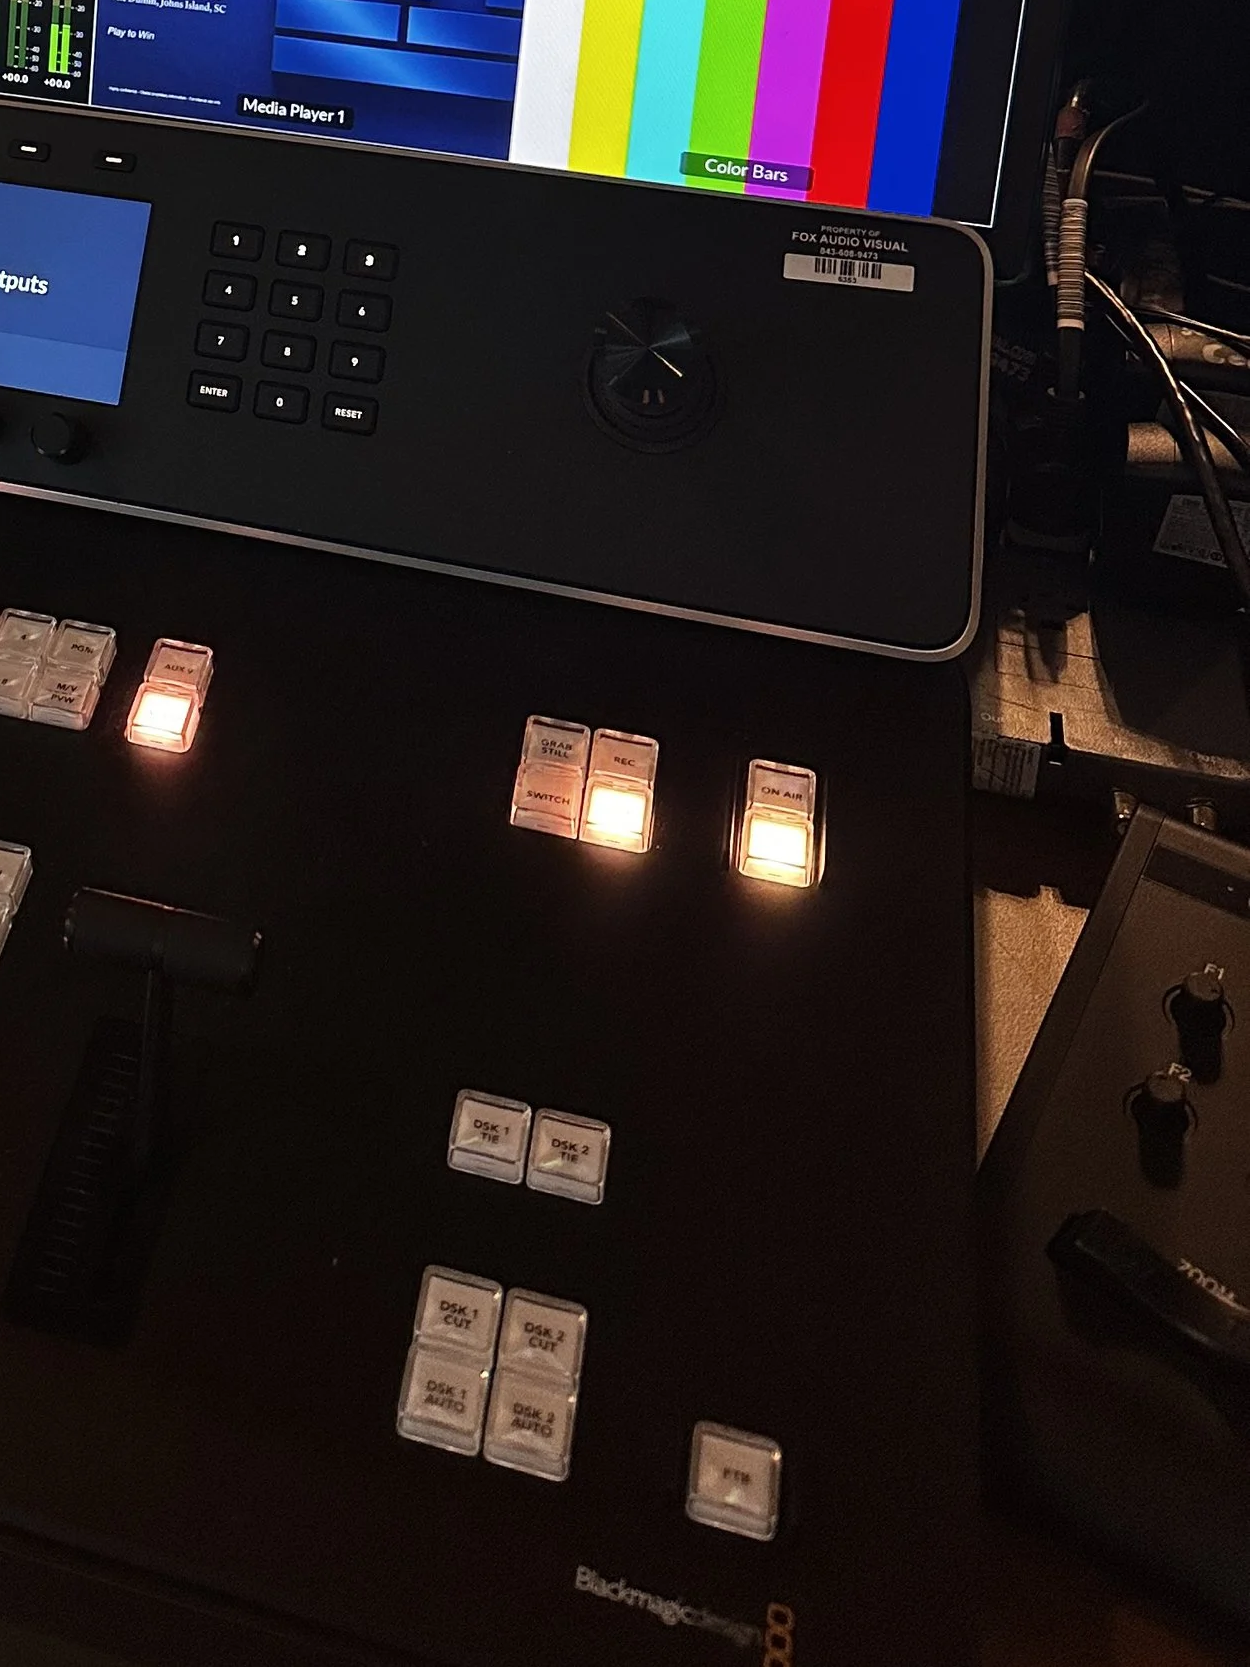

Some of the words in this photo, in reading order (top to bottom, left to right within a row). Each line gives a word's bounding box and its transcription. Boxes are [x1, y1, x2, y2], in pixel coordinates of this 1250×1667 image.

[185, 1, 212, 13] Island,
[214, 4, 226, 13] SC
[107, 26, 126, 38] Play
[127, 29, 136, 38] to
[138, 30, 155, 40] Win
[243, 98, 287, 116] Media
[290, 103, 335, 123] Player
[338, 110, 345, 124] 1
[704, 157, 749, 178] Color
[752, 163, 789, 183] Bars
[821, 225, 866, 237] PROPERTY
[792, 231, 817, 242] FOX
[819, 234, 860, 246] AUDIO
[863, 238, 909, 252] VISUAL
[200, 386, 228, 397] ENTER
[335, 408, 362, 420] RESET
[541, 739, 573, 751] GRAB
[542, 746, 569, 759] STILL
[613, 756, 635, 767] REC
[526, 790, 571, 806] SWITCH
[761, 786, 781, 796] ON
[782, 789, 803, 800] AIR
[1204, 963, 1225, 981] F1
[1168, 1062, 1192, 1082] F2
[473, 1119, 499, 1132] DSK
[504, 1126, 510, 1135] 1
[481, 1132, 500, 1144] TIE
